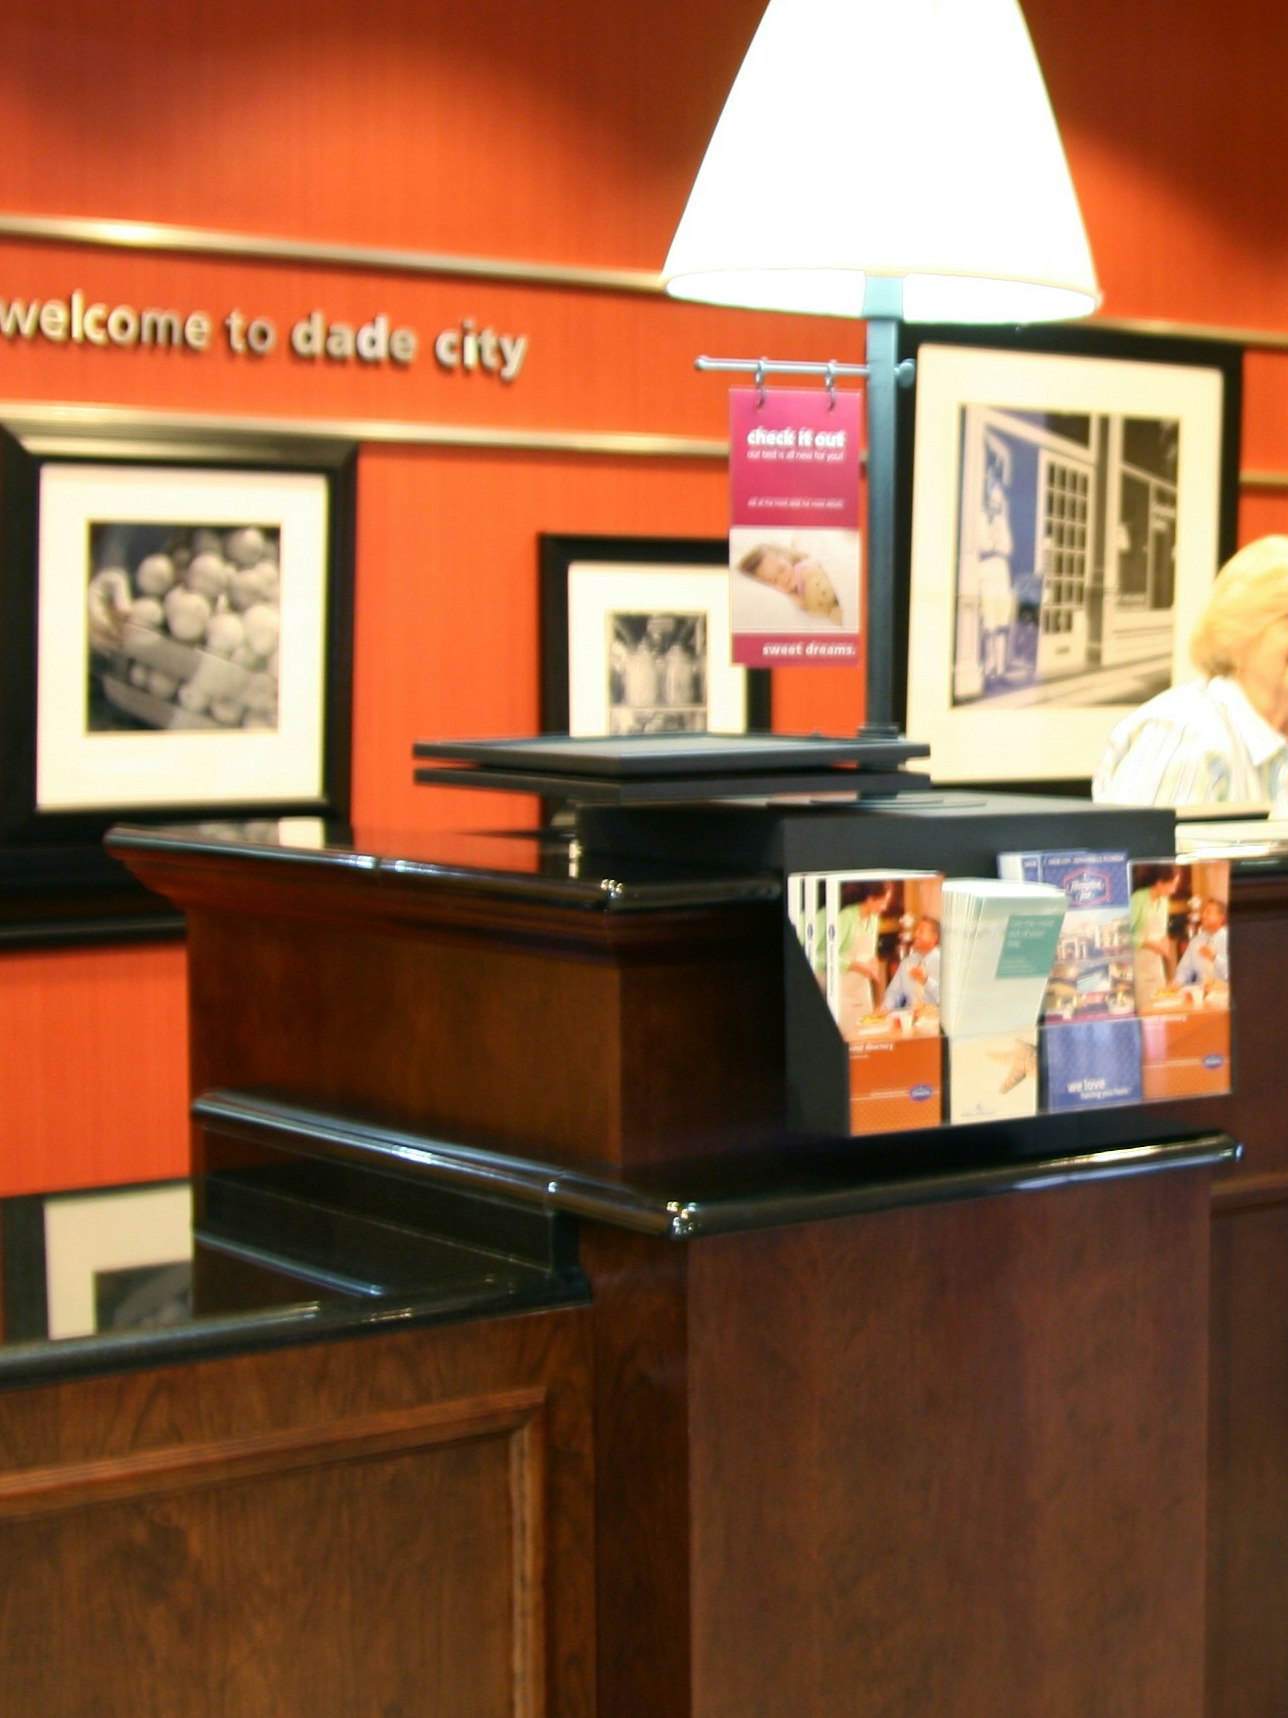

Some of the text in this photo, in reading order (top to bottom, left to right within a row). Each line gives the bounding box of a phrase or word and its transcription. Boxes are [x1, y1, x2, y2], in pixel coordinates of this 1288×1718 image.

[0, 289, 527, 381] welcome to dade city
[747, 427, 846, 447] check it out
[762, 643, 803, 655] sweet
